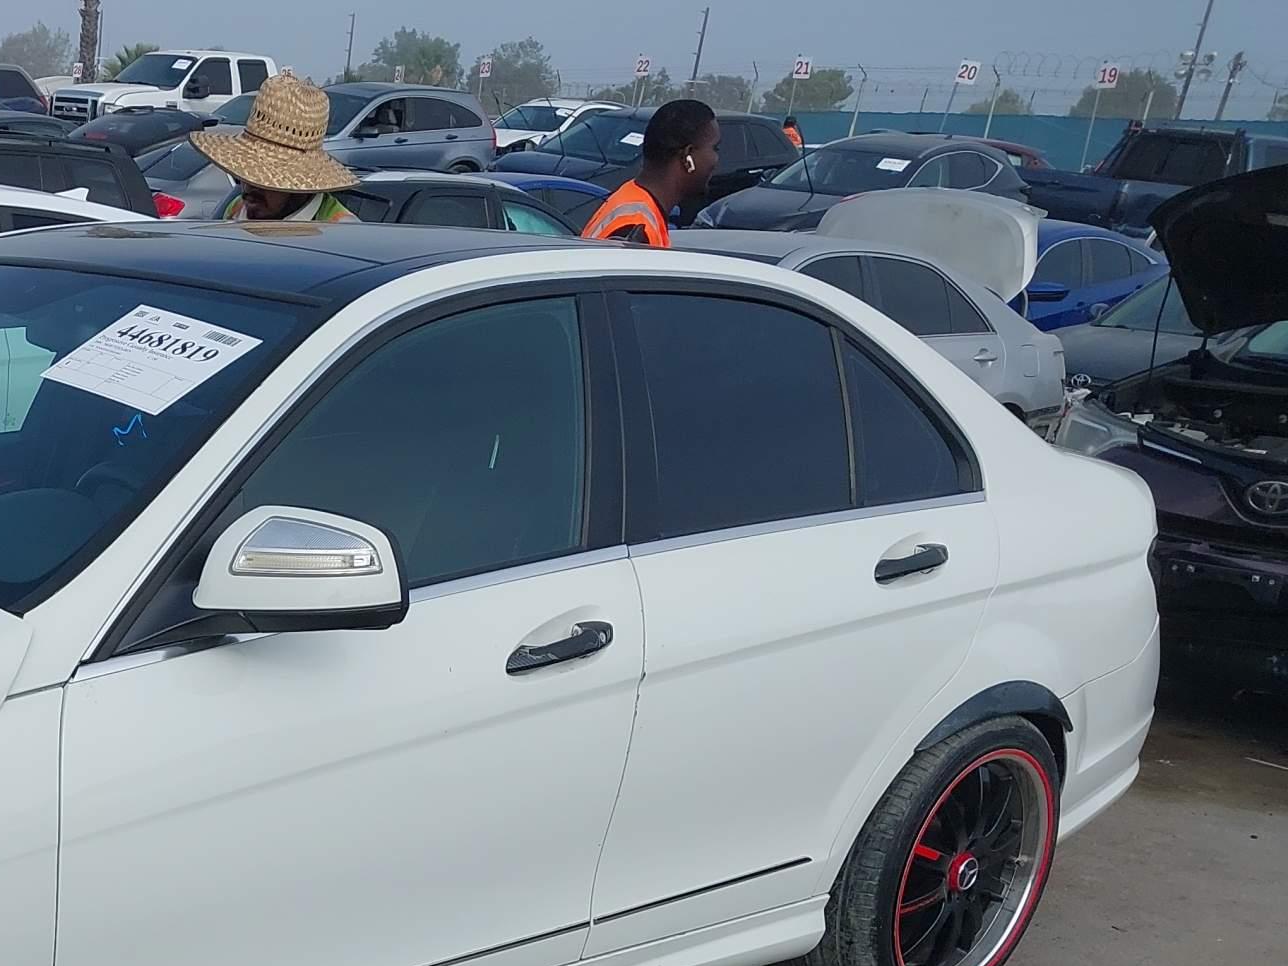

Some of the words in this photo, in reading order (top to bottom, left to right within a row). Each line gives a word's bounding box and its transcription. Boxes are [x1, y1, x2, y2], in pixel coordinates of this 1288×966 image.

[73, 64, 82, 76] 28
[480, 61, 491, 74] 23
[636, 59, 650, 73] 22
[795, 61, 810, 75] 21
[957, 64, 978, 80] 20
[1098, 67, 1118, 84] 19
[116, 324, 220, 362] 44681819
